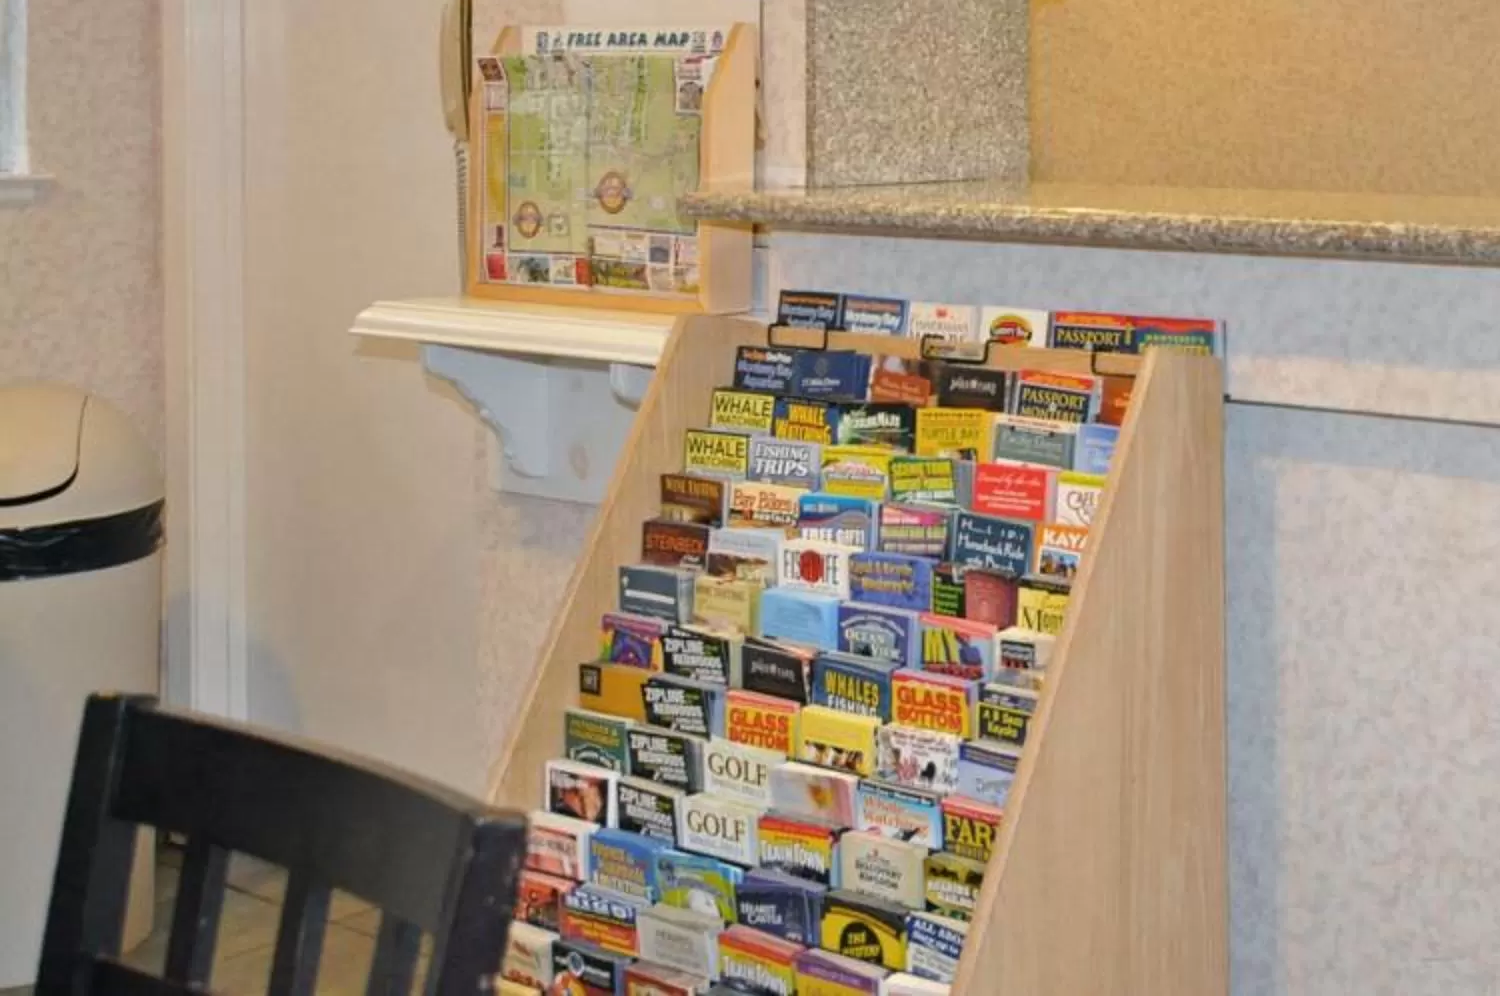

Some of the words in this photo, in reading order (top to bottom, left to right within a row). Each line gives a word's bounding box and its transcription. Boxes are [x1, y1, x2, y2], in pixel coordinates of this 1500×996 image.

[567, 30, 603, 47] FREE
[607, 30, 649, 47] AREA
[653, 30, 691, 47] MAP
[1056, 329, 1122, 347] PASSPORT
[714, 394, 772, 417] WHALE
[1022, 387, 1086, 408] PASSPORT
[715, 412, 769, 428] WATCHING
[788, 404, 827, 427] WHALE
[687, 435, 746, 459] WHALE
[756, 443, 811, 461] FISHING
[689, 453, 742, 470] WATCHING
[755, 458, 809, 478] TRIPS
[825, 670, 880, 706] WHALES
[896, 685, 962, 713] GLASS
[827, 694, 878, 718] FISHING
[896, 705, 962, 731] BOTTOM
[729, 707, 788, 733] GLASS
[728, 726, 788, 752] BOTTOM
[707, 752, 768, 787] GOLF
[687, 809, 746, 843] GOLF
[944, 813, 993, 850] FAR
